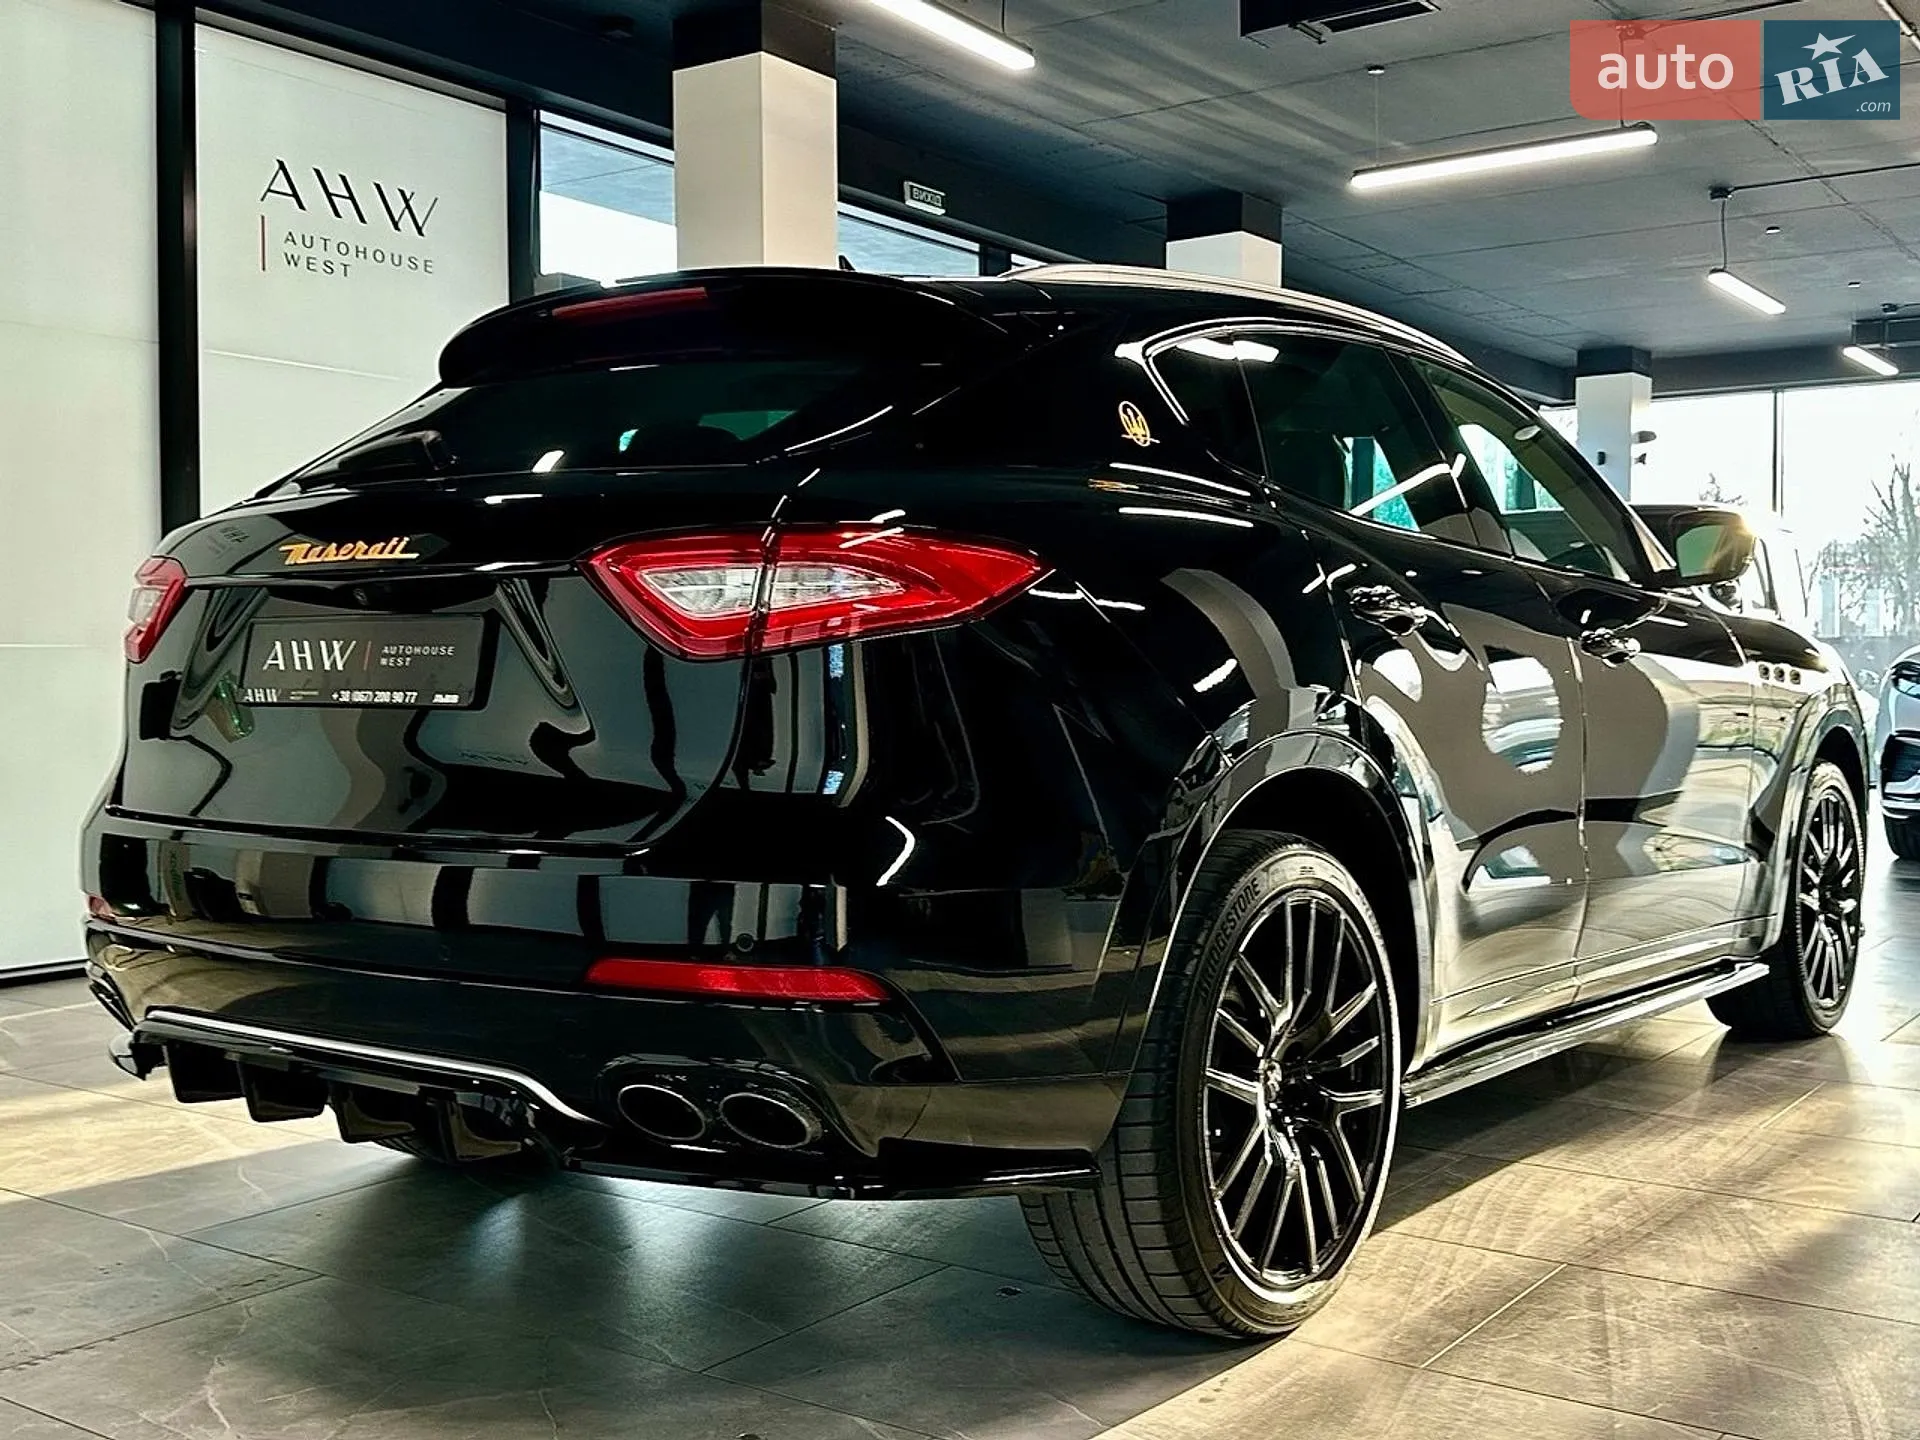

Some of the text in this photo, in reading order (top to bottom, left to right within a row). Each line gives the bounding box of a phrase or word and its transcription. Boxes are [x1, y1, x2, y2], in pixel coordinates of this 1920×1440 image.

[260, 158, 439, 237] AHW
[284, 231, 434, 274] AUTOHOUSE
[284, 252, 352, 278] WEST
[279, 536, 420, 566] Maserati
[262, 640, 356, 671] AHW
[380, 657, 412, 667] WEST
[381, 645, 455, 656] AUTOHOUSE
[244, 688, 281, 702] AHW
